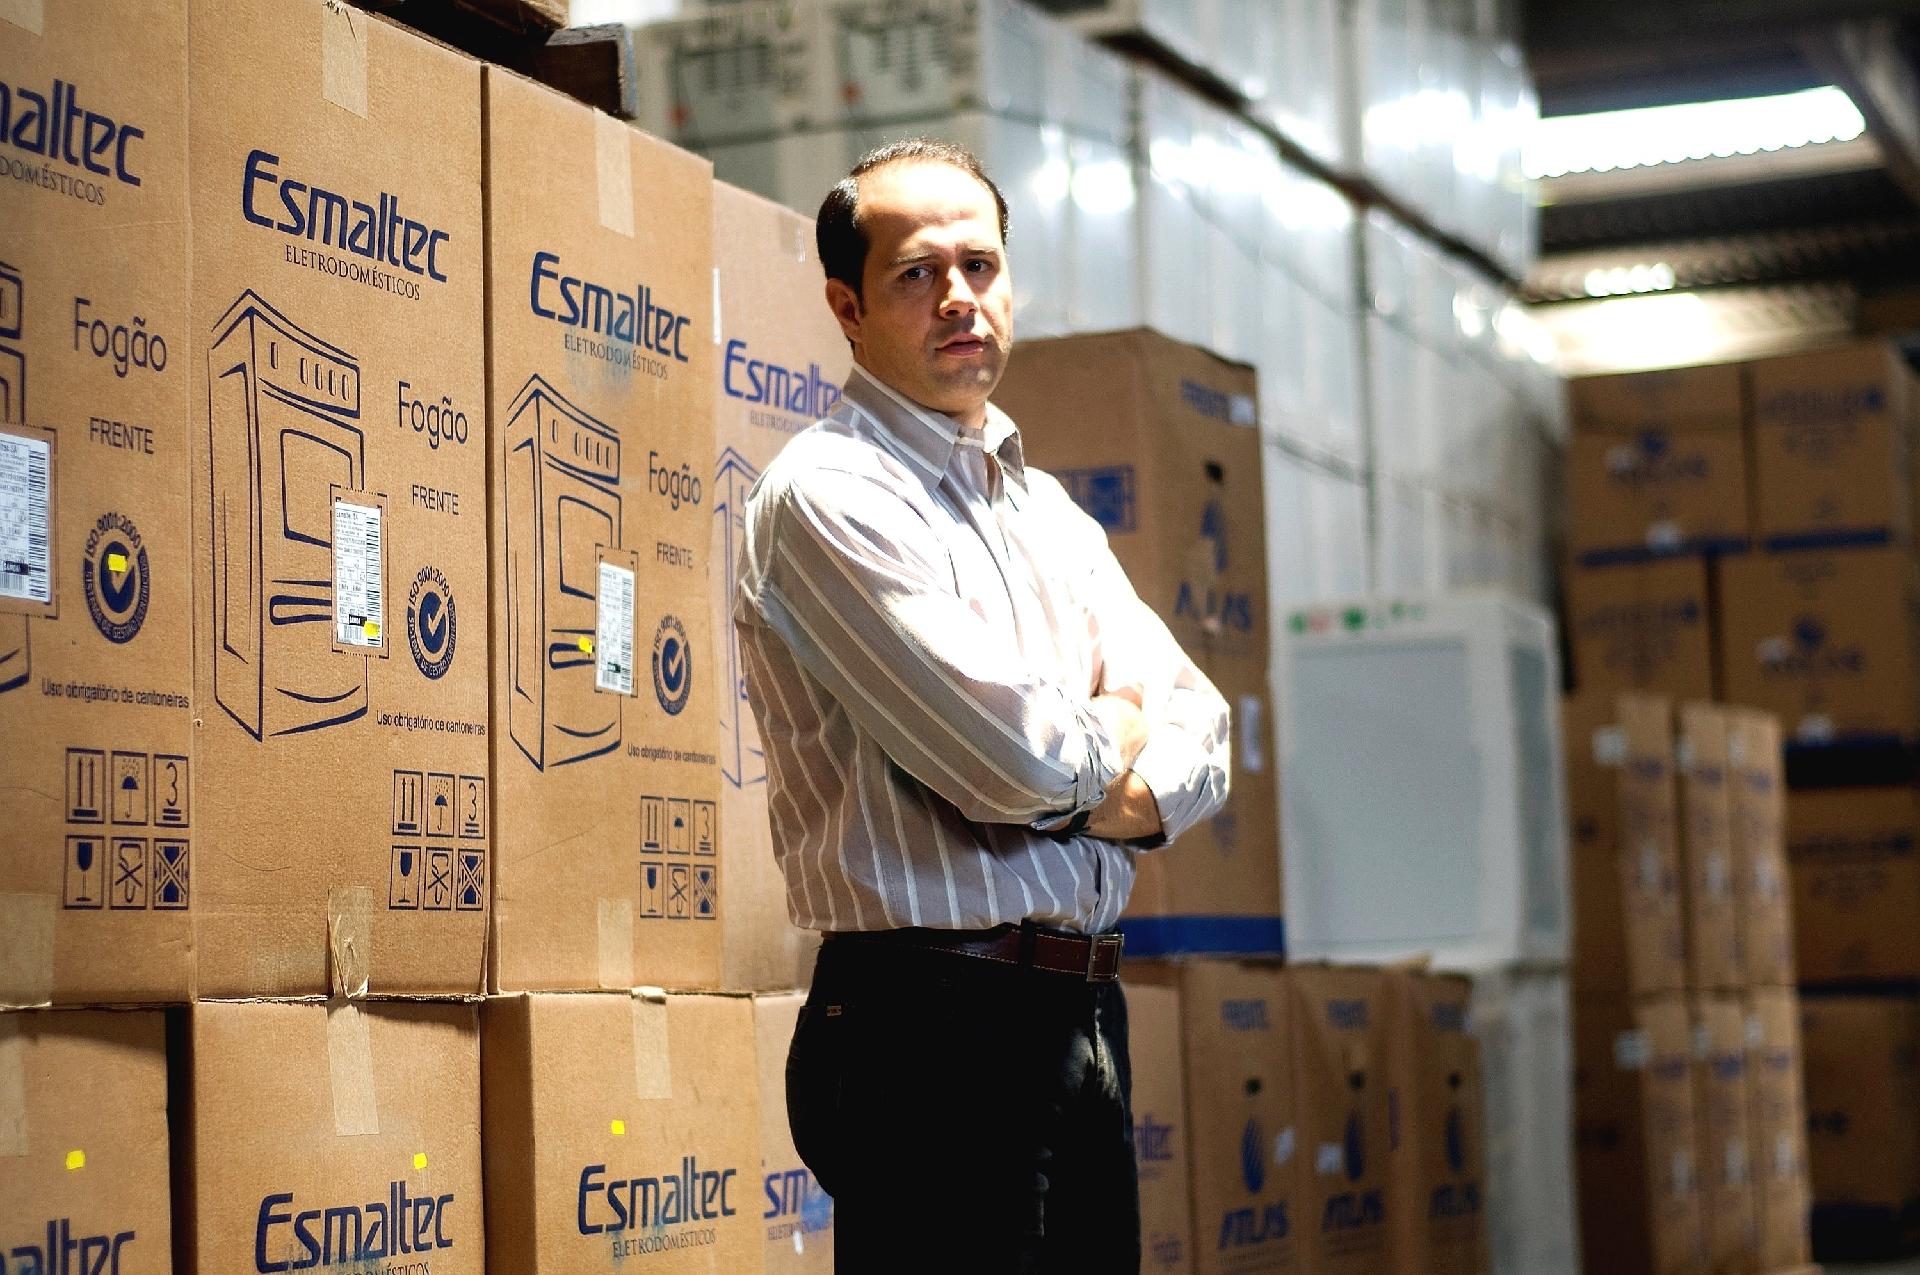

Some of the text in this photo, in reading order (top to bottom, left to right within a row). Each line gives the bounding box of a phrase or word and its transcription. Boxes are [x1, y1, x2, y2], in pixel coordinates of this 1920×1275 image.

[242, 149, 450, 283] Esmaltec
[285, 244, 420, 301] ELETRODOMÉSTICOS
[530, 251, 691, 363] Esmaltec
[74, 297, 167, 378] Fogão
[564, 333, 668, 381] ELETRODOMÉSTICOS
[89, 416, 154, 455] FRENTE
[398, 380, 468, 450] Fogão
[412, 484, 459, 516] FRENTE
[649, 450, 701, 511] Fogão
[656, 542, 693, 569] FRENTE
[42, 678, 62, 697] Uso
[376, 709, 392, 726] Uso
[394, 711, 433, 731] obrigatório
[446, 720, 486, 736] cantoneiras
[578, 1156, 737, 1235] Esmaltec
[255, 1181, 455, 1274] Esmaltec
[612, 1228, 717, 1258] ELETRODOMÉSTICOS
